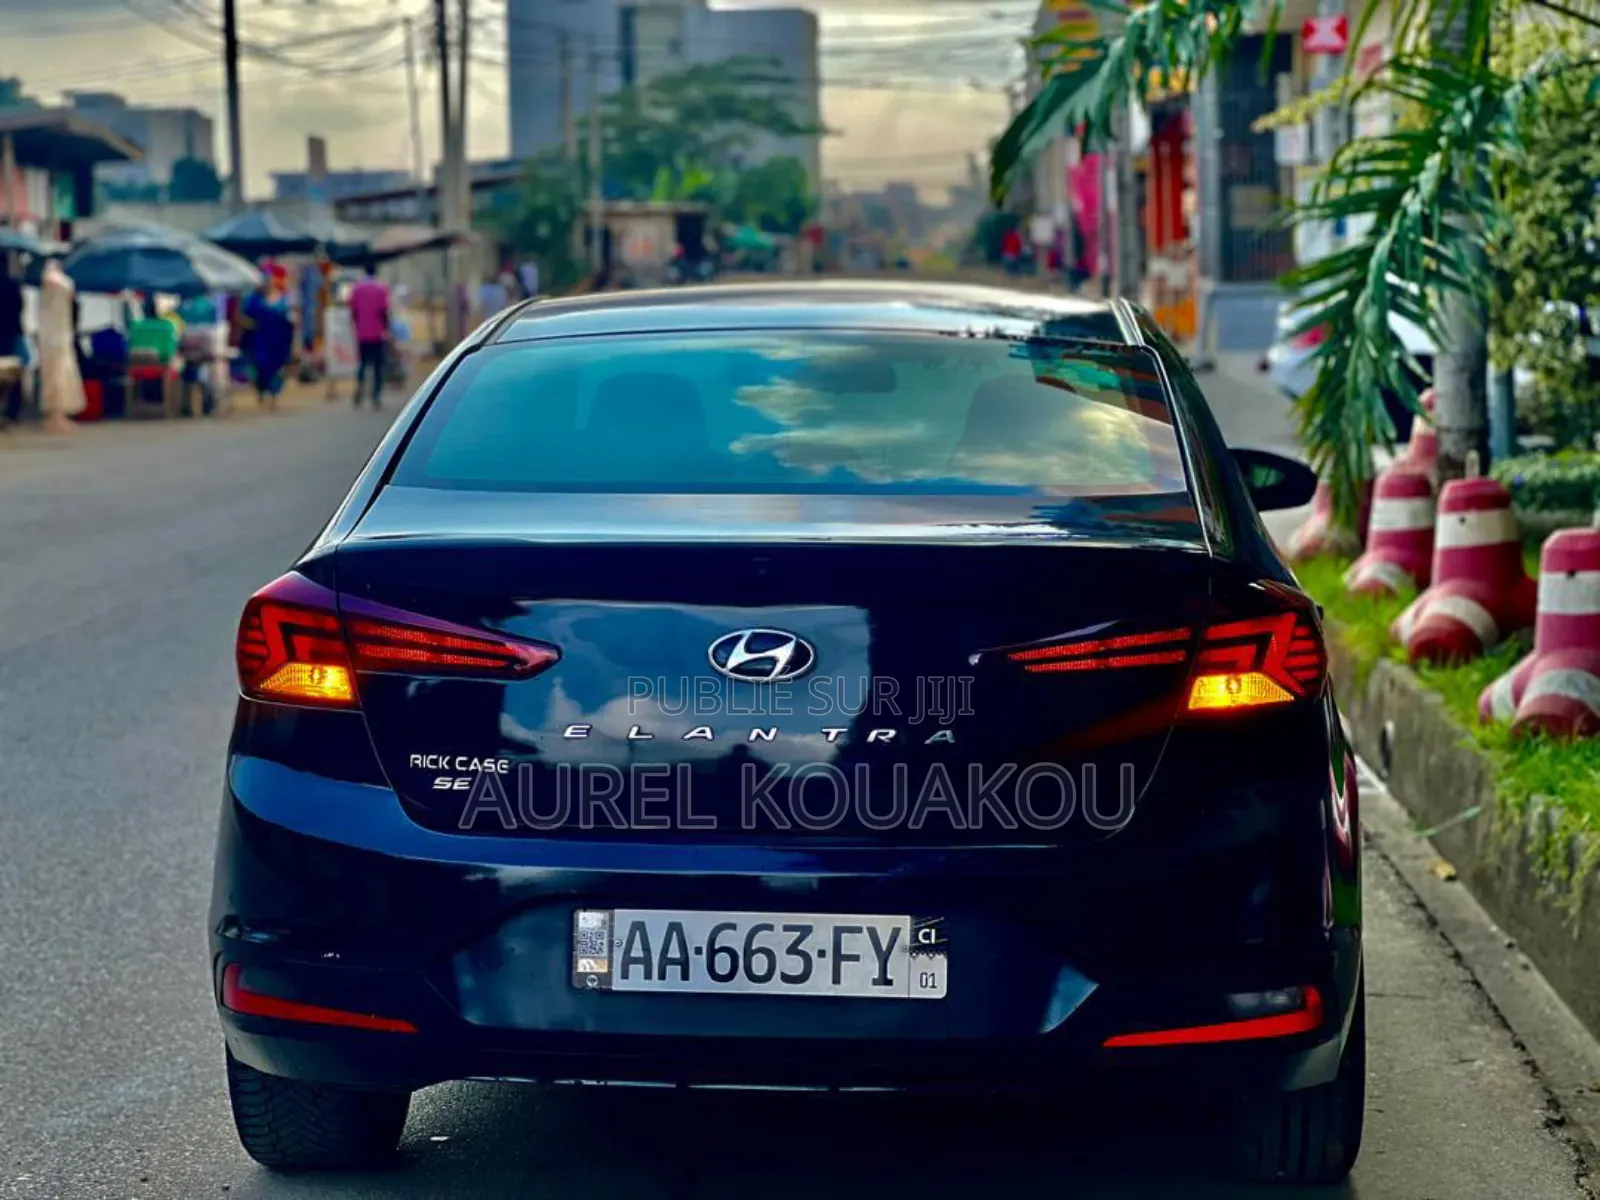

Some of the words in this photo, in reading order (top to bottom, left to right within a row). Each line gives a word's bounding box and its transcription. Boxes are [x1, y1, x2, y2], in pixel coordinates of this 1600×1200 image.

[563, 724, 956, 744] ELANTRA
[410, 754, 450, 770] RICK
[455, 756, 509, 774] CASE
[432, 776, 472, 790] SE
[918, 928, 936, 944] CI
[919, 971, 937, 989] 01
